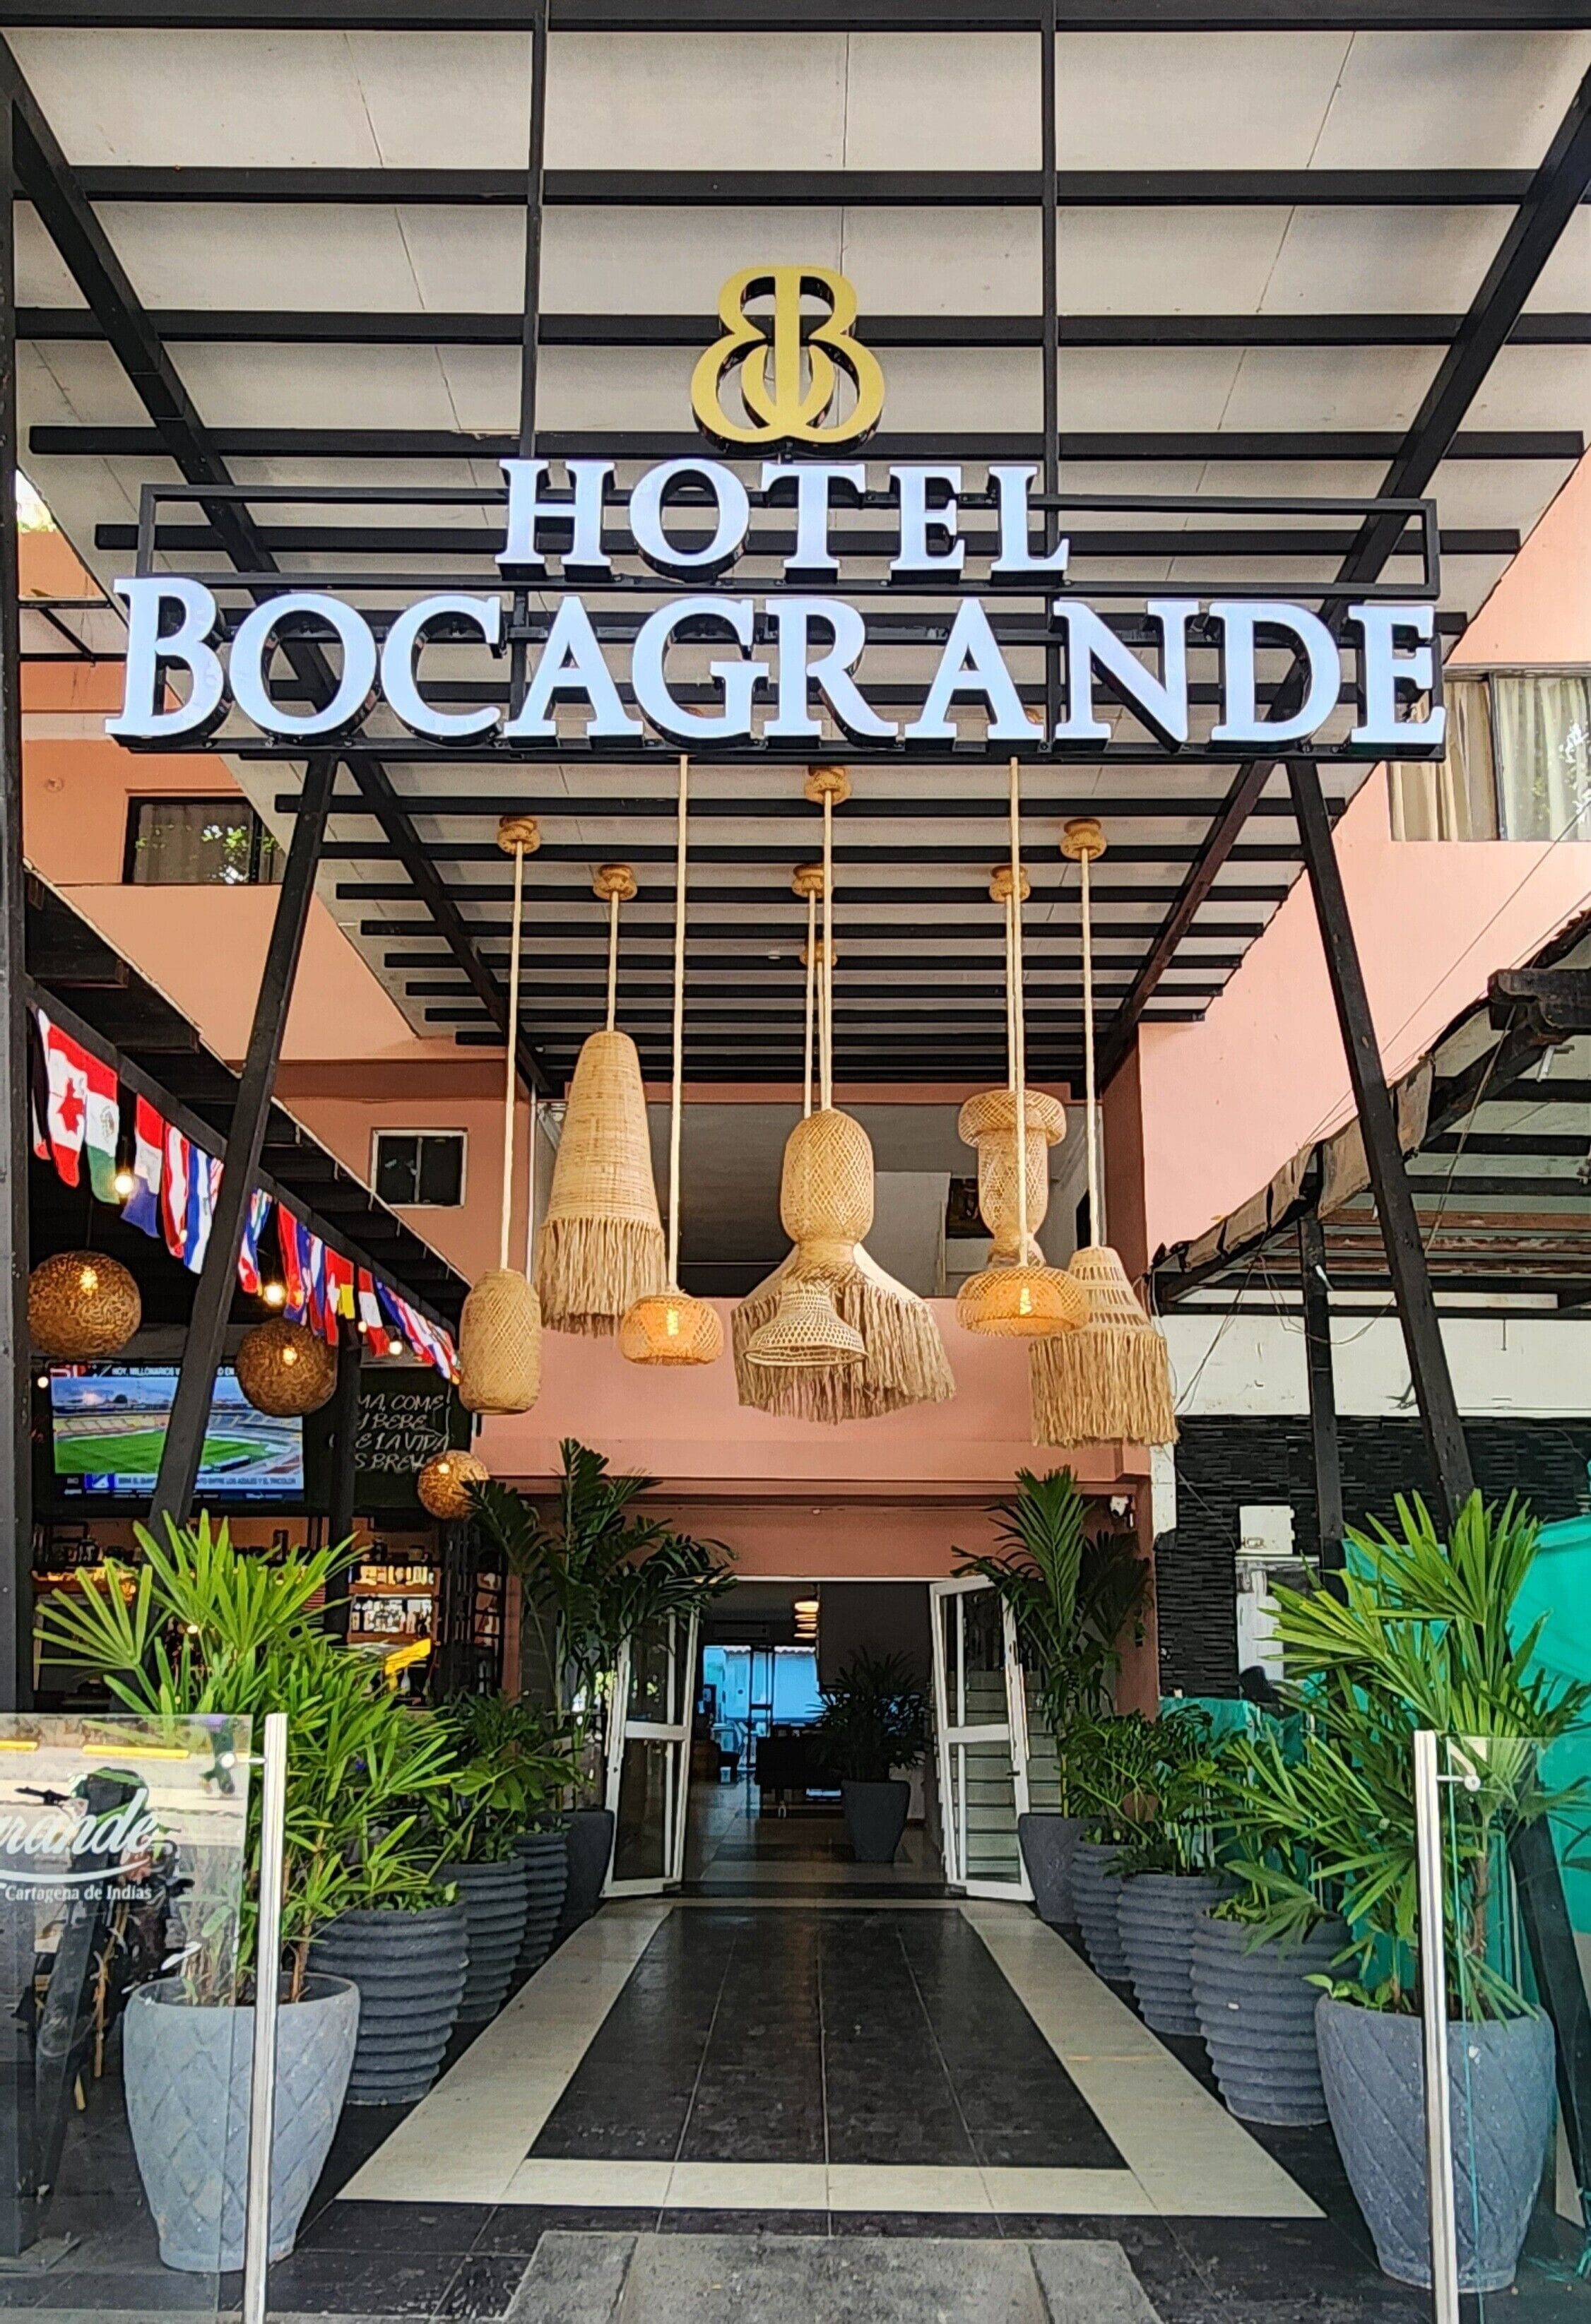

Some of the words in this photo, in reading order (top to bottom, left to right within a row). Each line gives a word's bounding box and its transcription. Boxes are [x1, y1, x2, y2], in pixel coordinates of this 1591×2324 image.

[495, 456, 1070, 576] HOTEL
[104, 575, 1447, 749] BOCAGRANDE
[391, 1394, 444, 1412] COME
[372, 1413, 428, 1430] BEBE
[374, 1433, 401, 1450] LA
[405, 1433, 450, 1452] VIDA
[372, 1452, 427, 1474] BREV
[4, 1884, 80, 1903] Cartagena
[83, 1884, 103, 1901] de
[106, 1884, 152, 1901] Indias
